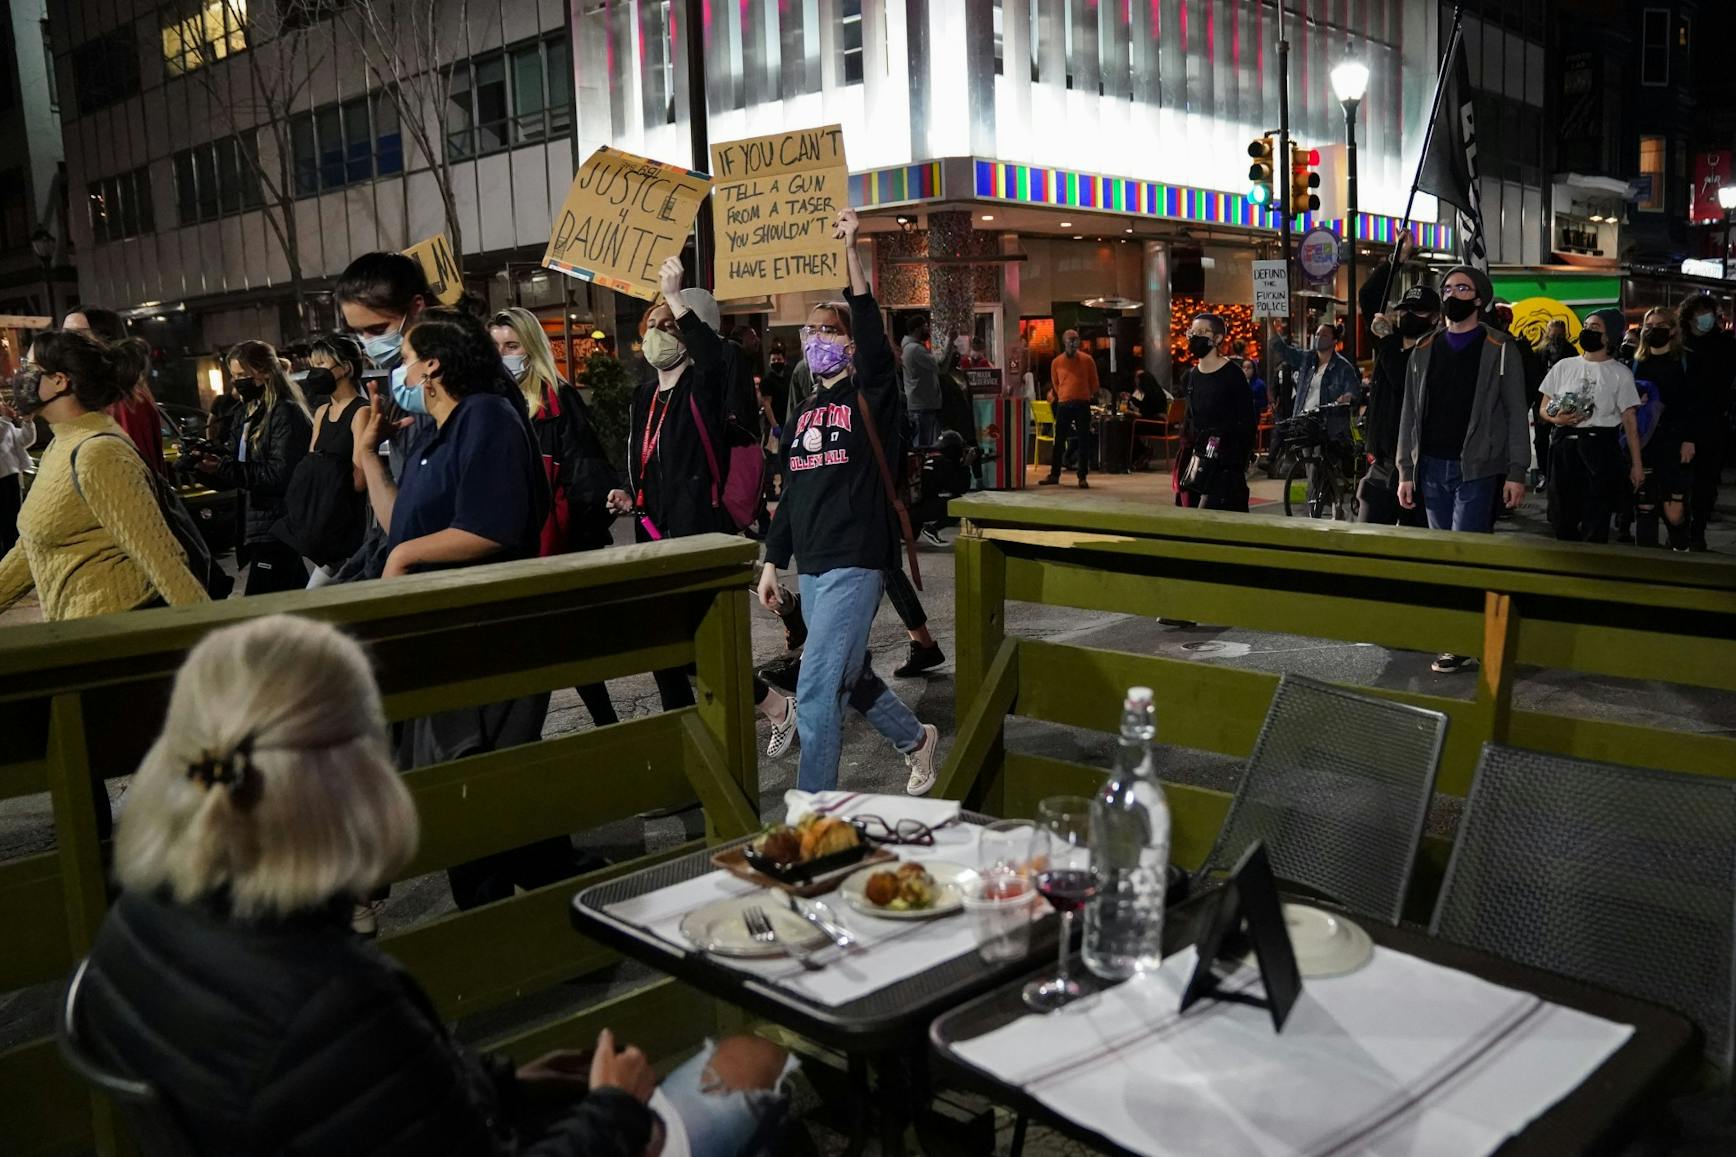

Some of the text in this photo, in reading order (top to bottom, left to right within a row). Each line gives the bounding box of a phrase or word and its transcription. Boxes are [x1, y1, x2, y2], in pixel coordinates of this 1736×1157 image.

[718, 129, 843, 177] IF YOU CAN'T
[720, 174, 826, 202] TELL A GUN
[618, 207, 629, 224] 4
[727, 197, 836, 226] FROM A TASER
[553, 209, 674, 283] DAUNTE
[725, 216, 829, 252] YOU SHOULDN'T
[729, 252, 837, 280] HAVE EITHER!
[1253, 268, 1287, 280] DEFUND
[1256, 291, 1286, 300] FUCKIN
[1256, 301, 1287, 312] POLICE
